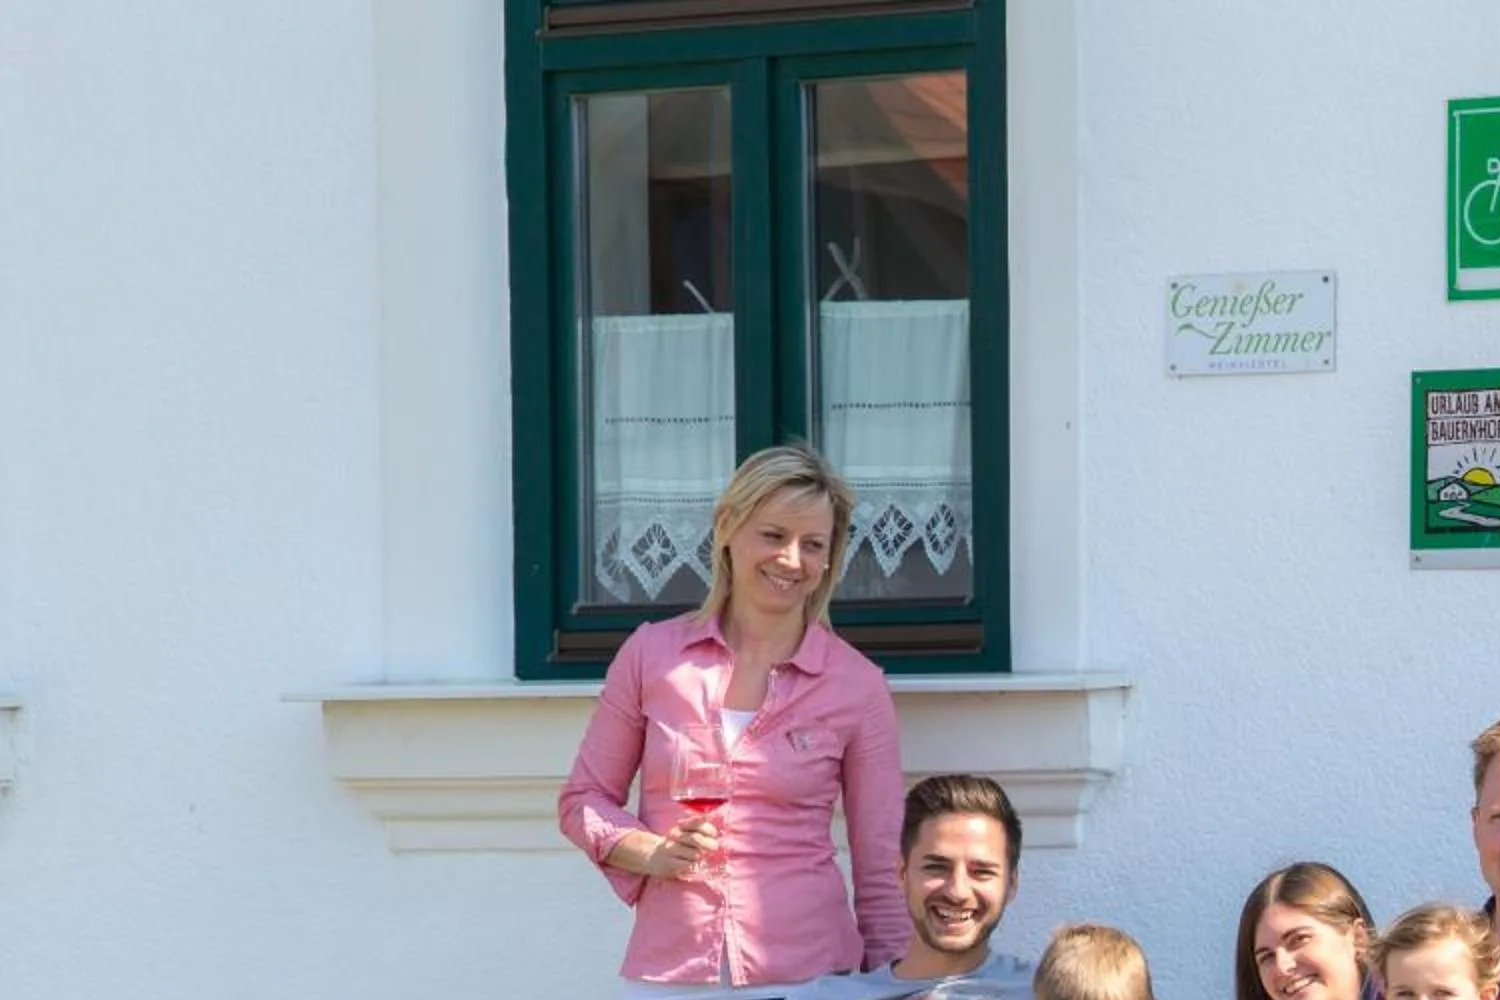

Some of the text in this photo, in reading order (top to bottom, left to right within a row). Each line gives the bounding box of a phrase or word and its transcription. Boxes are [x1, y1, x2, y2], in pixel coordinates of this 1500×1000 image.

[1171, 279, 1305, 328] Genießer
[1175, 319, 1332, 356] Zimmer
[1431, 393, 1479, 415] URLAUB
